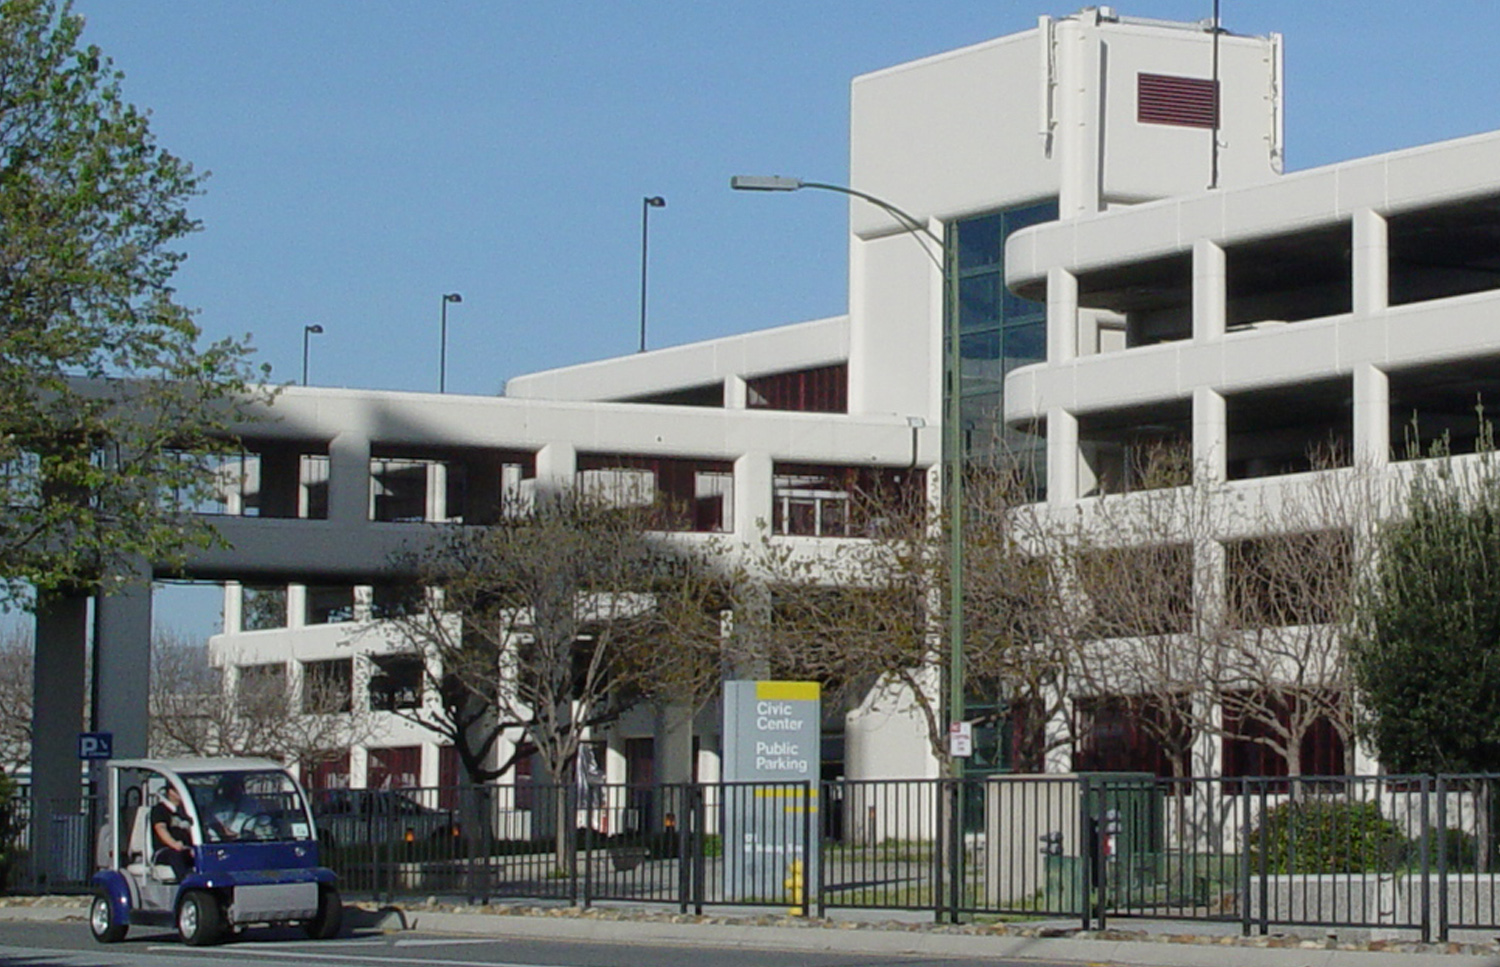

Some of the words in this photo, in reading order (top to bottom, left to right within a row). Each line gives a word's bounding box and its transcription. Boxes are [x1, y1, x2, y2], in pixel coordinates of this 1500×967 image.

[756, 701, 793, 716] Civic
[756, 716, 803, 731] Center
[81, 736, 98, 757] P
[755, 742, 799, 756] Public
[755, 756, 808, 773] Parking
